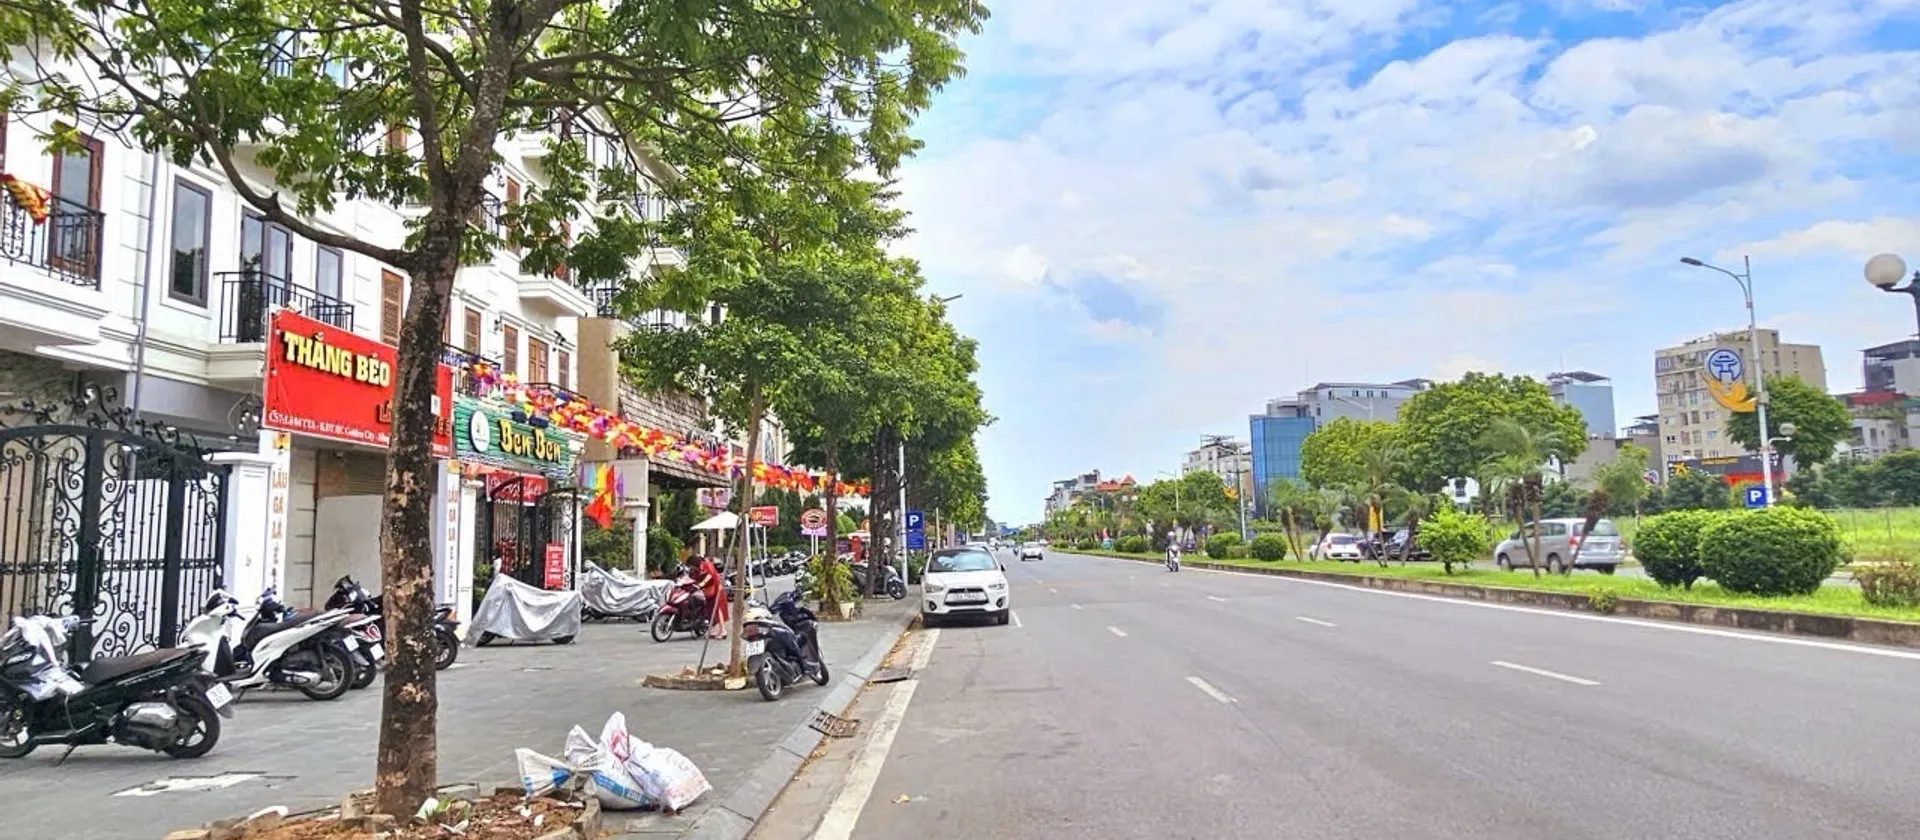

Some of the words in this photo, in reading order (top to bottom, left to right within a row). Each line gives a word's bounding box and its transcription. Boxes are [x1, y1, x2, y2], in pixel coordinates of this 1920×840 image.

[284, 330, 353, 379] THẮNG
[356, 352, 391, 388] BÉO
[500, 418, 531, 457] Ben
[535, 428, 561, 463] Ben
[1750, 490, 1762, 502] P
[909, 514, 920, 527] P
